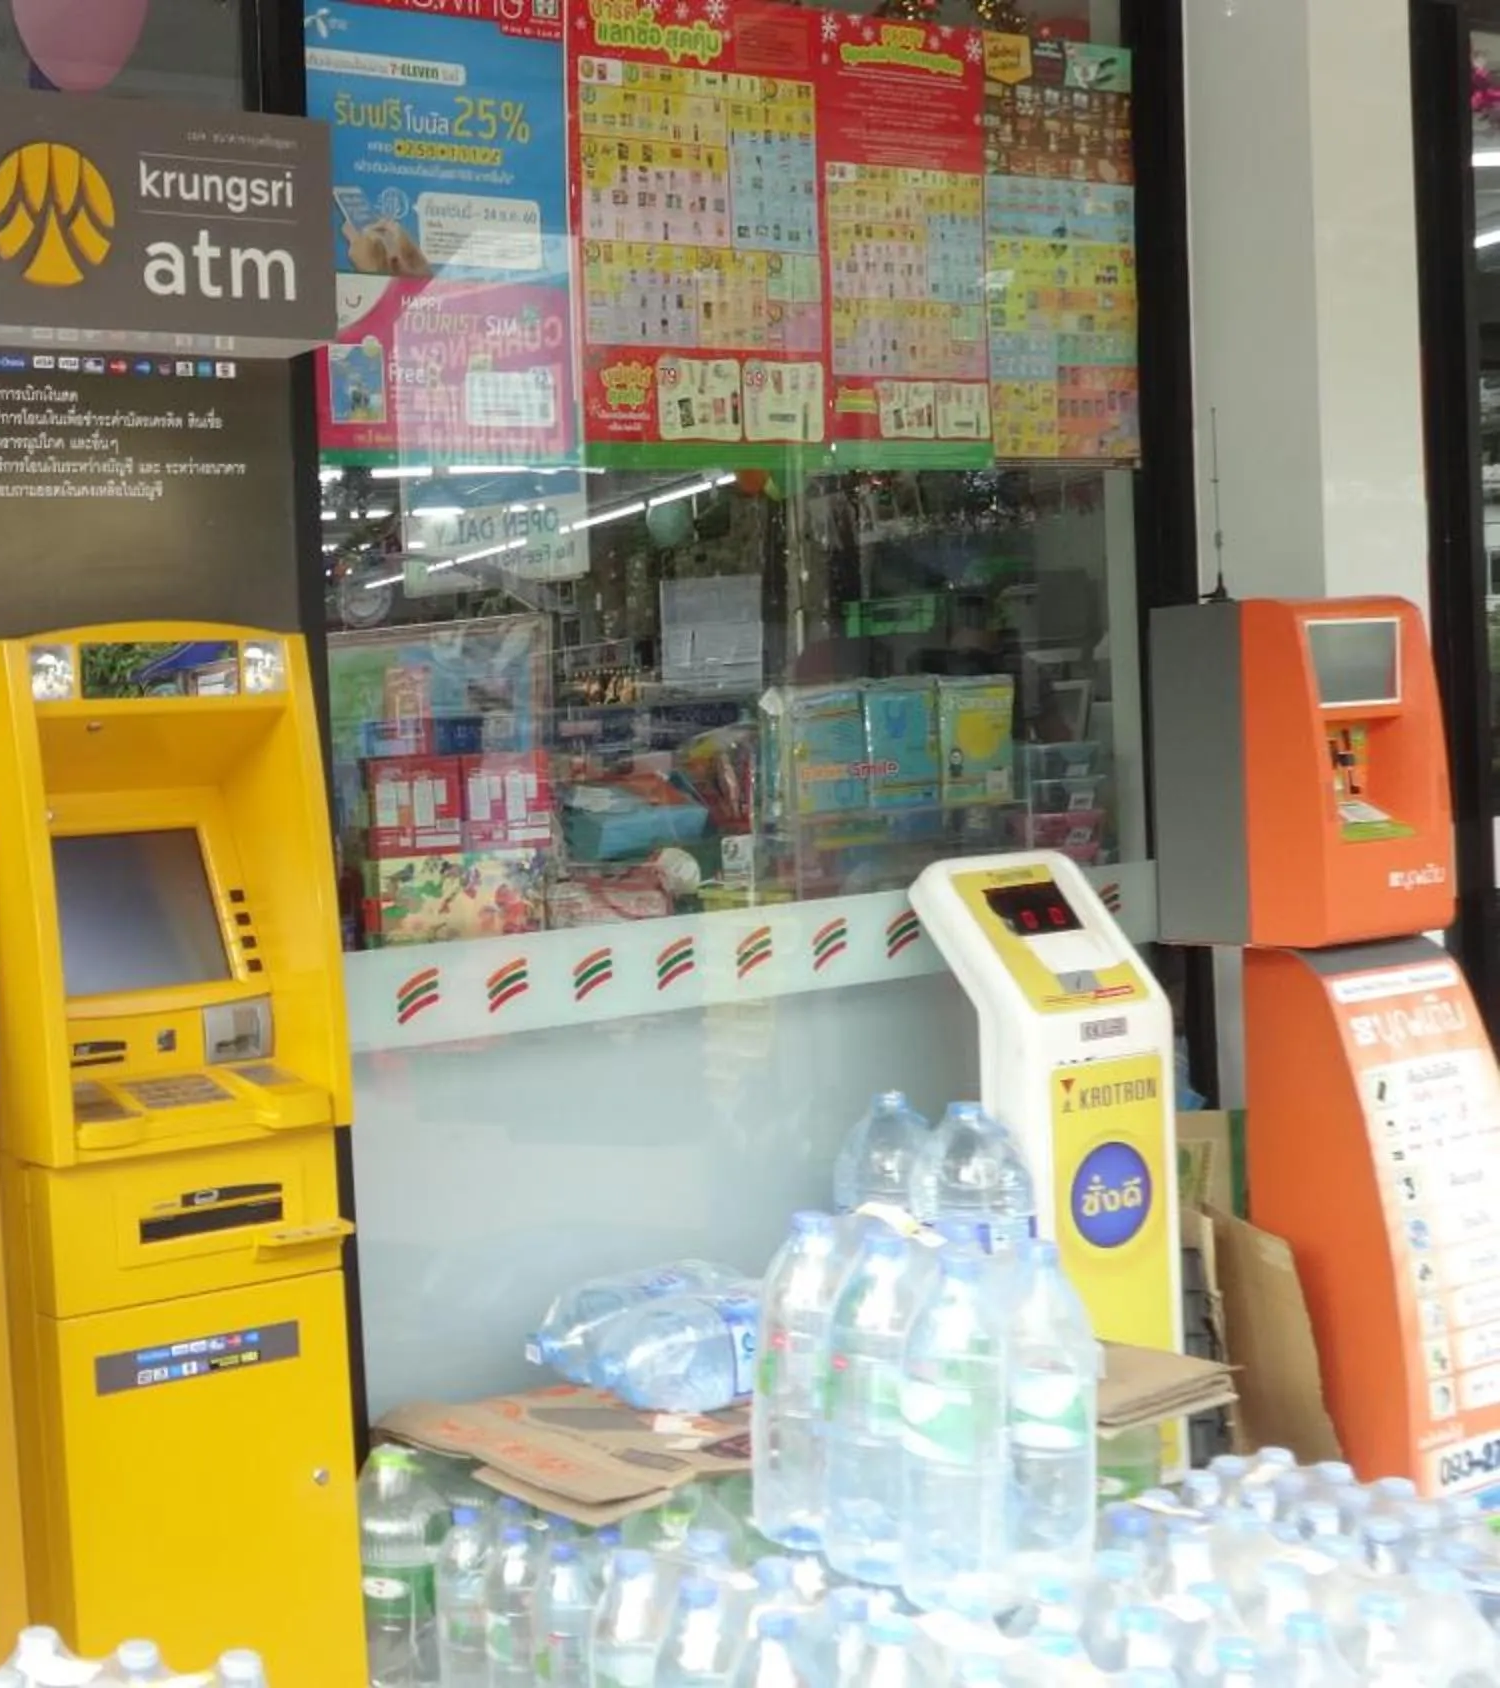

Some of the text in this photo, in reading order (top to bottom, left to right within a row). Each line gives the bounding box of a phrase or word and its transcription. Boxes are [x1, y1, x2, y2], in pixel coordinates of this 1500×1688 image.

[453, 97, 531, 144] 25%
[138, 160, 293, 213] krungsri
[143, 229, 297, 301] atm
[1082, 1174, 1143, 1217] ชั่งดี
